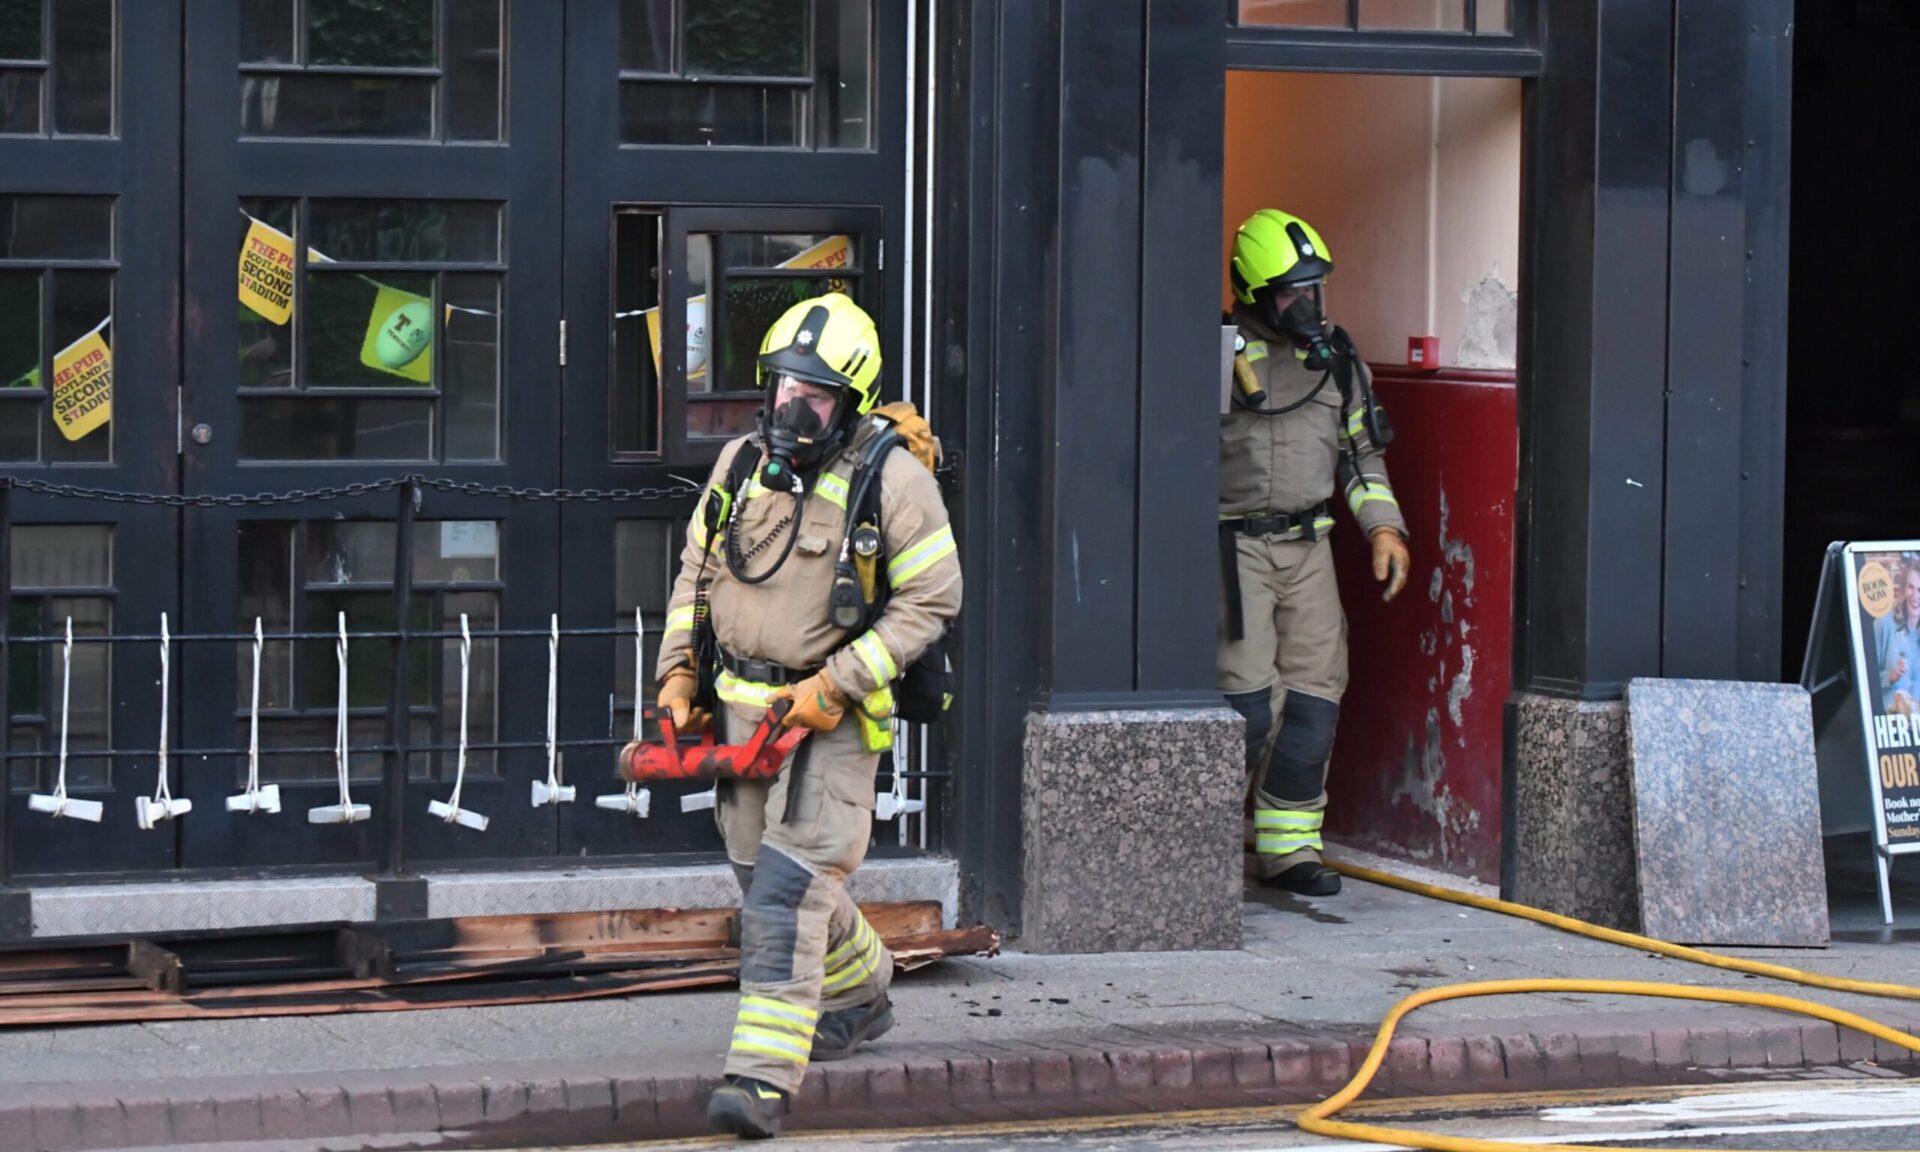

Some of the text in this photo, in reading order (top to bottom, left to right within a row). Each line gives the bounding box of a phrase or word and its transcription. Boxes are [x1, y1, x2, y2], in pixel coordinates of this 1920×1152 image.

[251, 236, 279, 261] THE
[240, 273, 289, 310] STADIUM
[242, 260, 293, 297] SECOND
[393, 312, 412, 332] T
[54, 348, 104, 389] HE PUB
[54, 359, 110, 399] COTLAND'S
[62, 387, 112, 426] STADIU
[1874, 714, 1912, 749] HER
[1880, 753, 1919, 789] OUR
[1884, 796, 1909, 810] Book
